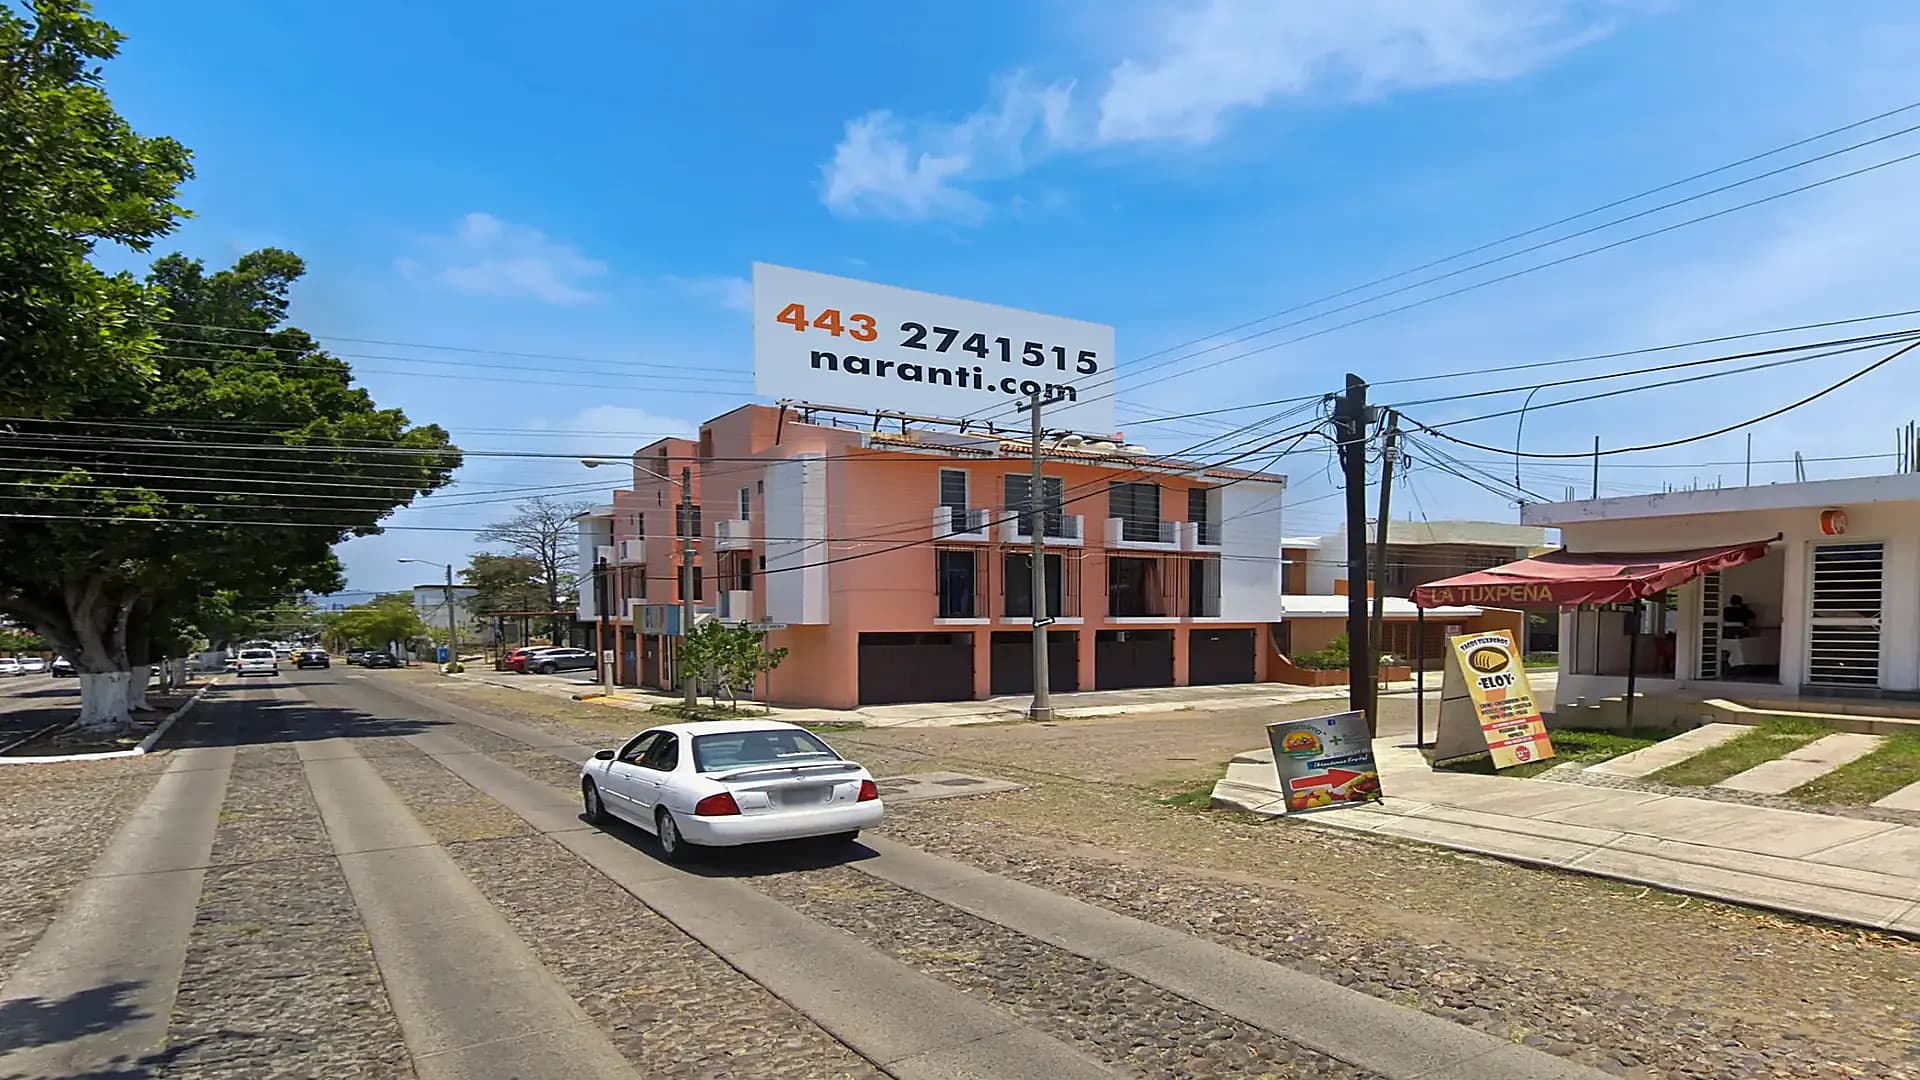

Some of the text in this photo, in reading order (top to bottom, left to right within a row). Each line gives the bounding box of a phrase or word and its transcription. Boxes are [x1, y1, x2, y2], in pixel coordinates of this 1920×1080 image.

[776, 303, 1098, 374] 443 2741515
[810, 350, 1078, 402] naranti.com
[1432, 587, 1455, 602] LA
